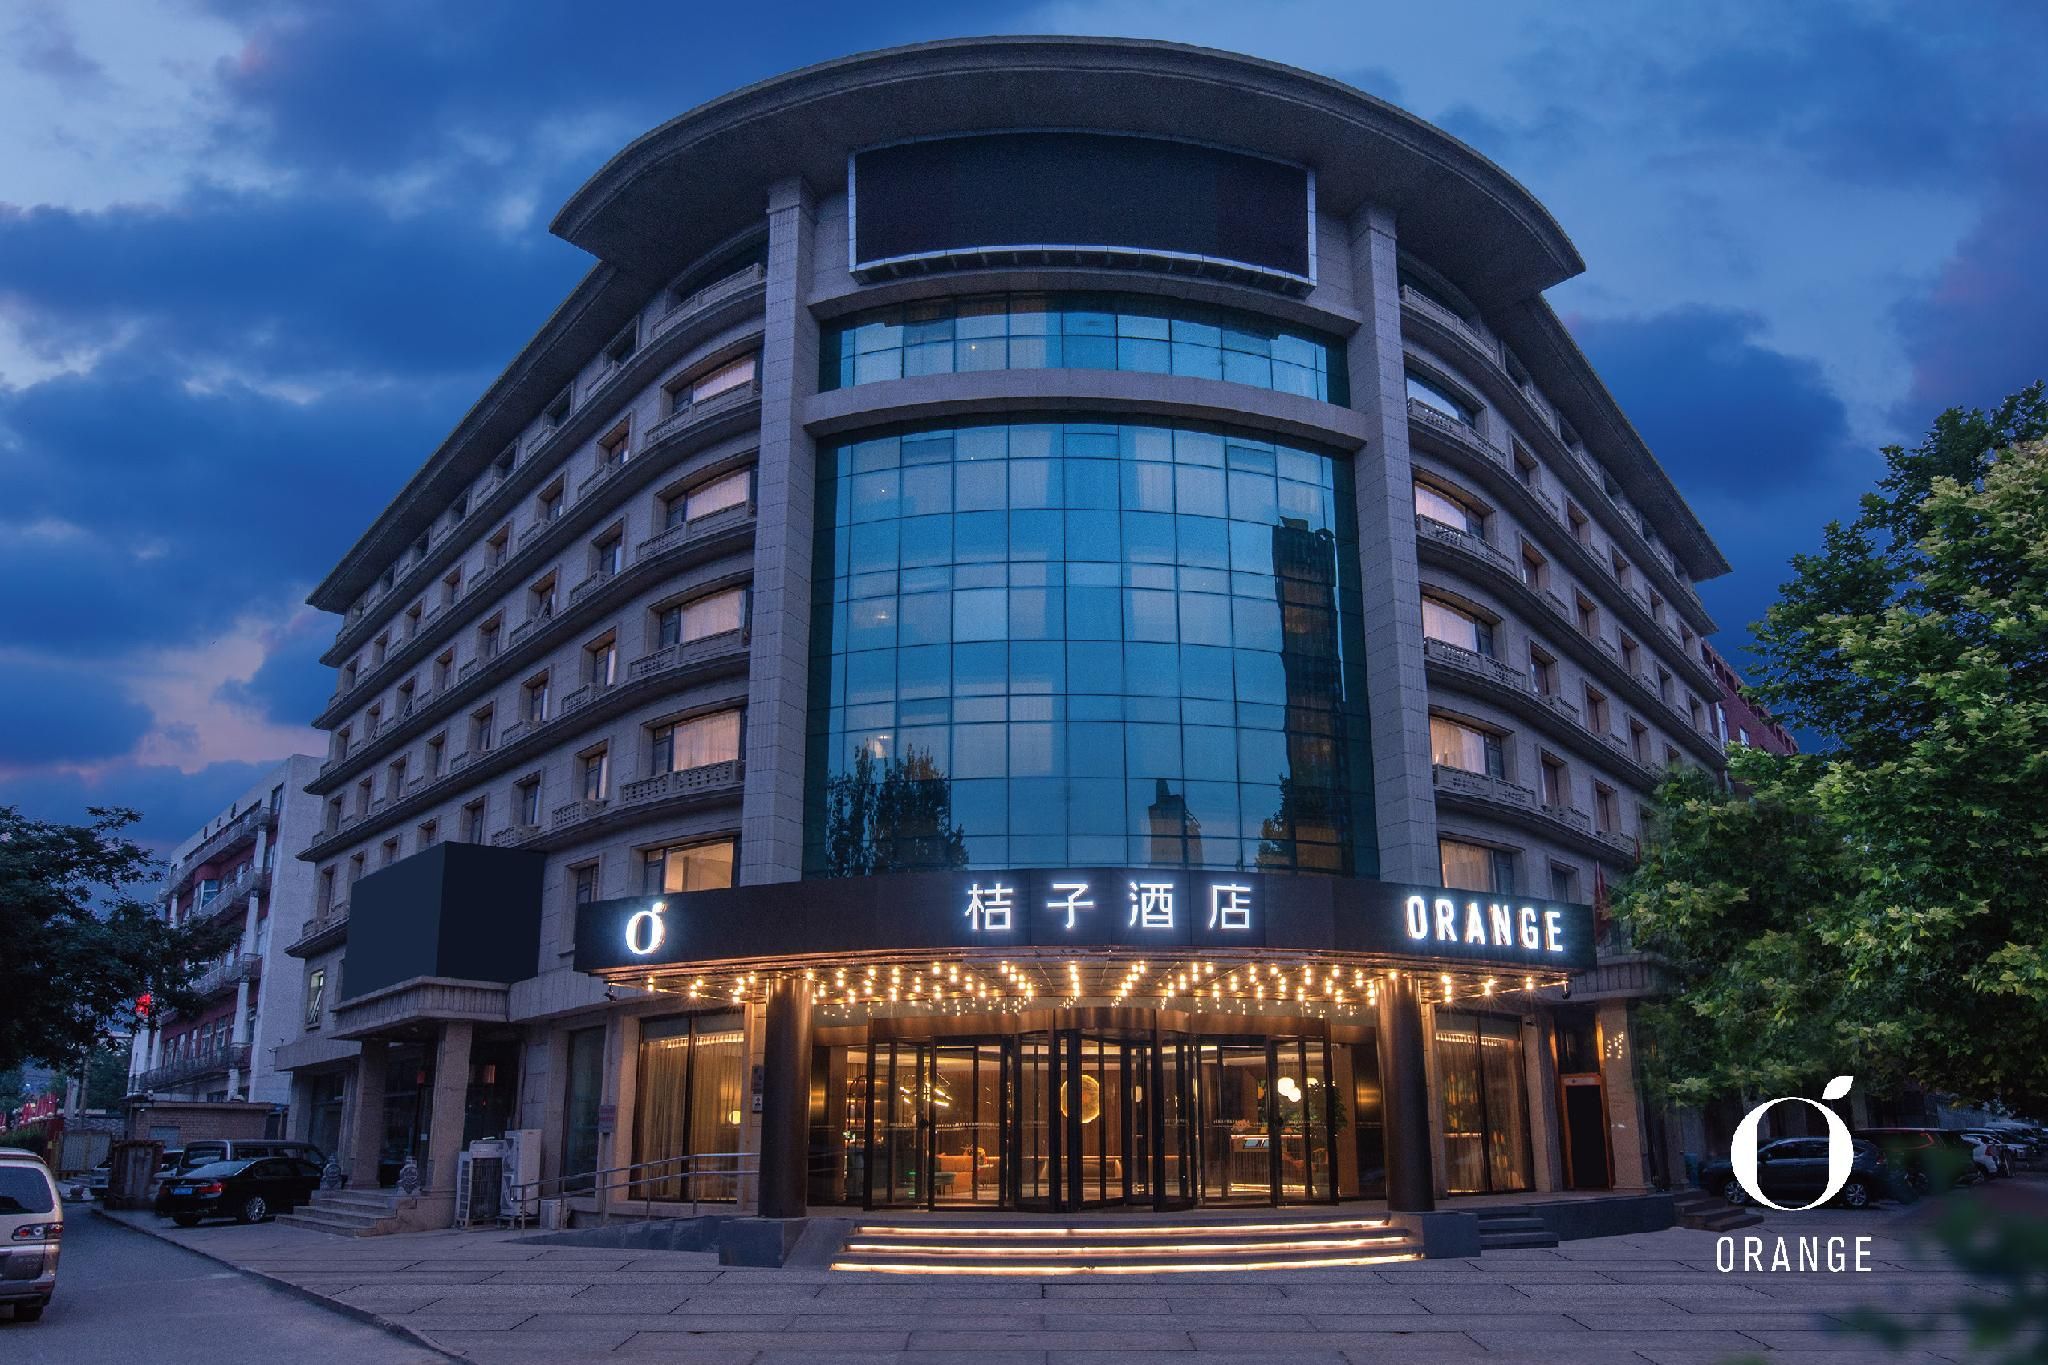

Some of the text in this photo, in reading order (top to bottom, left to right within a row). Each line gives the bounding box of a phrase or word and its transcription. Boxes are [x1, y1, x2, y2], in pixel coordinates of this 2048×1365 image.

[964, 881, 1252, 930] 桔子酒店
[1405, 895, 1564, 952] ORANGE
